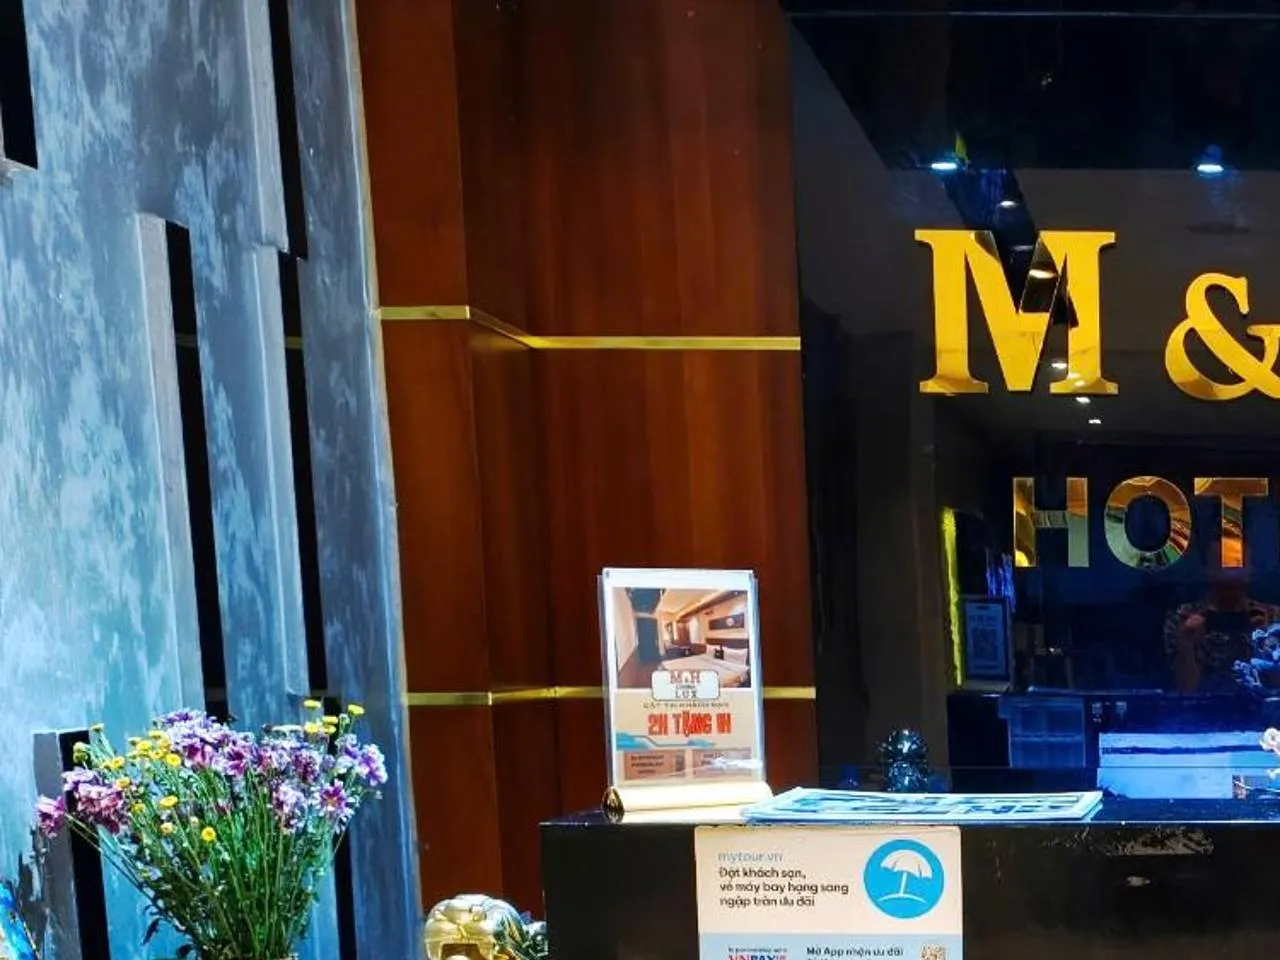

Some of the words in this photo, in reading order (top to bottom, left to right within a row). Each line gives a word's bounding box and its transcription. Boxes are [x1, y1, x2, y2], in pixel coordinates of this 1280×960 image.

[914, 229, 1119, 395] M
[763, 883, 785, 894] bay
[824, 947, 843, 958] App
